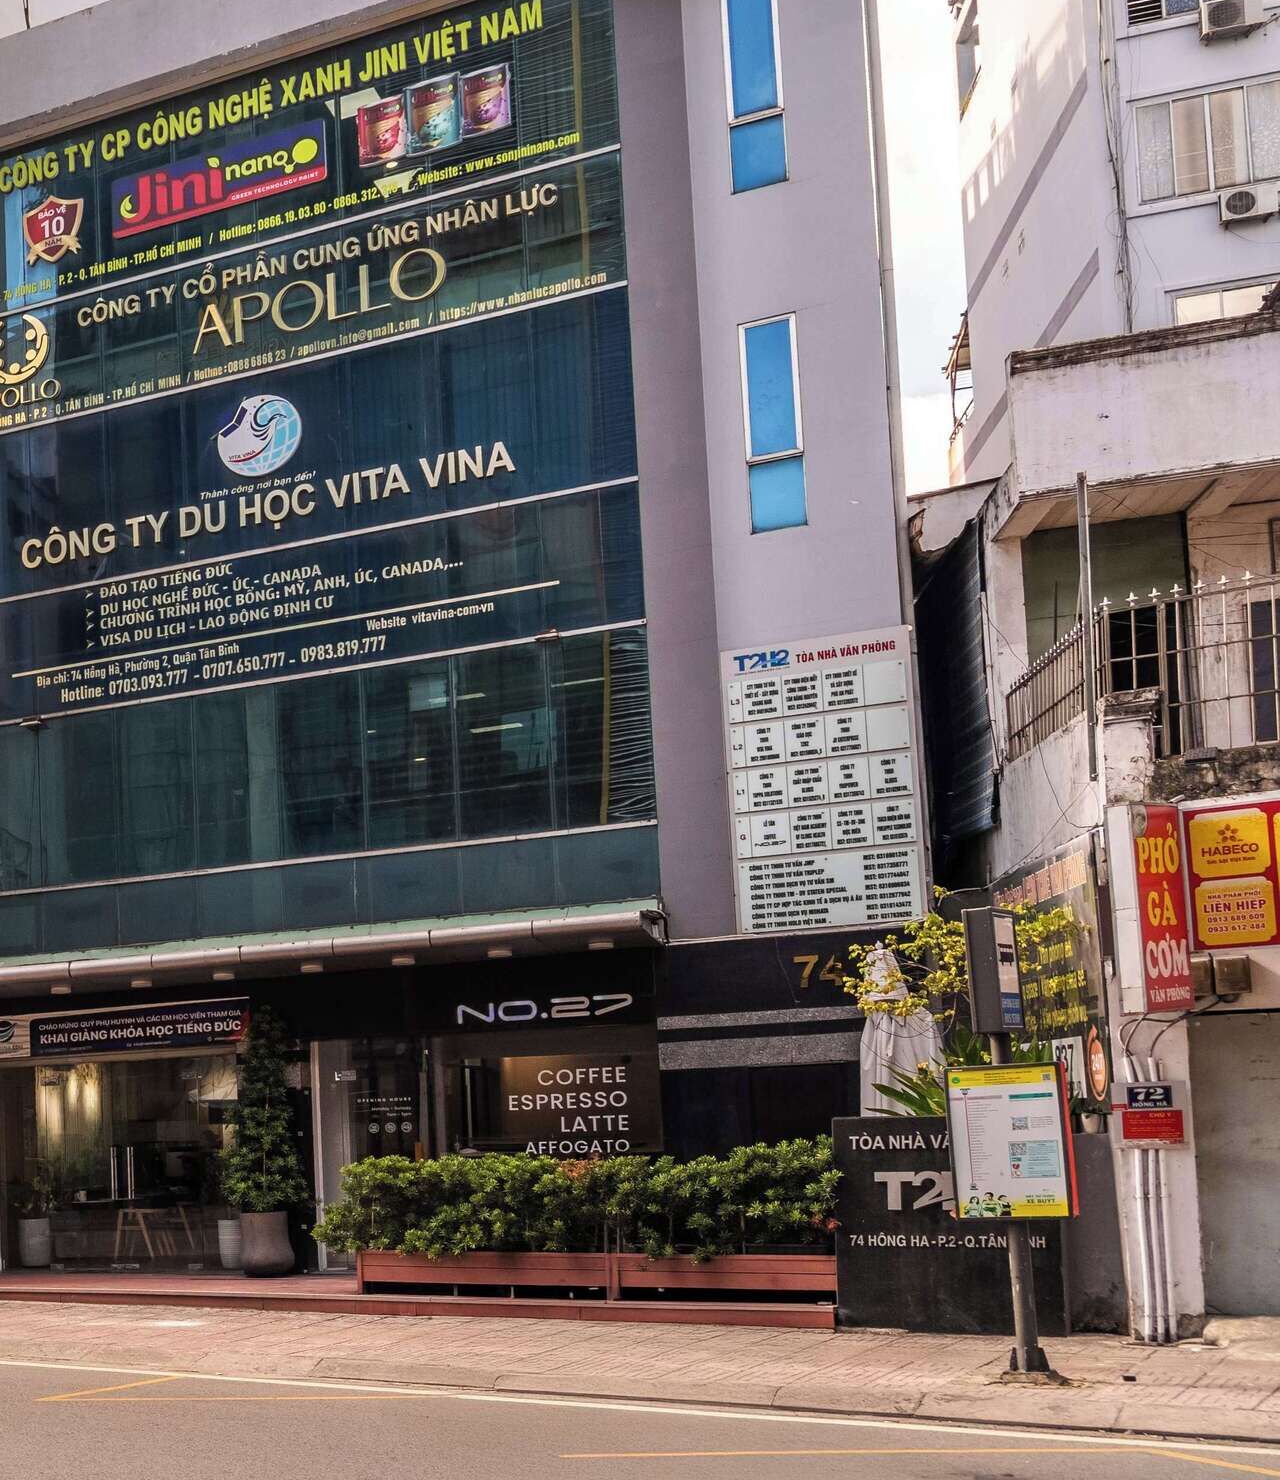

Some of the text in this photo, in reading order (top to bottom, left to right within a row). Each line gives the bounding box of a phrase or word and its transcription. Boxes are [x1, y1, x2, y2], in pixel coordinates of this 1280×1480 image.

[65, 140, 94, 172] TY
[101, 129, 130, 160] CP
[137, 106, 202, 150] CÔNG
[209, 80, 272, 130] NGHỆ
[280, 59, 351, 107] XANH
[359, 42, 406, 83] JINI
[413, 20, 471, 63] VIỆT
[120, 157, 223, 224] Jini
[177, 237, 201, 253] MINH
[465, 132, 580, 173] www.sonjininano.com
[41, 216, 64, 238] 10
[77, 183, 558, 327] CÔNG TY CỔ PHẦN CUNG ỨNG NHÂN LỰC
[193, 247, 447, 355] APOLLO
[158, 373, 181, 389] MINH
[21, 441, 516, 569] CÔNG TY DU HỌC VITA VINA
[200, 488, 229, 501] Thành
[100, 601, 120, 616] DU
[126, 594, 148, 612] HỌC
[263, 564, 322, 585] CANADA
[131, 578, 157, 595] TẠO
[161, 568, 201, 588] TIẾNG
[206, 563, 233, 579] ĐỨC
[100, 610, 154, 630] CHƯƠNG
[158, 604, 200, 624] TRÌNH
[206, 594, 232, 612] HỌC
[100, 628, 131, 647] VISA
[135, 627, 153, 641] DU
[156, 623, 185, 640] LỊCH
[199, 613, 225, 630] LAO
[229, 606, 269, 626] ĐỘNG
[273, 598, 310, 619] ĐỊNH
[71, 670, 82, 682] 74
[125, 656, 159, 675] Phường
[173, 650, 197, 665] Quận
[199, 646, 216, 661] Tân
[218, 642, 240, 657] Bình
[733, 649, 790, 672] T2H2
[795, 640, 896, 663] TÒA NHÀ VĂN PHÒNG
[61, 635, 386, 703] Hotline: 0703.093.777 0707.650.777 0983.819.777
[1136, 823, 1180, 874] PHỞ
[1201, 843, 1259, 858] HABECO
[1148, 881, 1177, 926] GÀ
[1146, 932, 1189, 979] CƠM
[207, 1010, 228, 1018] THAM
[457, 993, 632, 1025] NO.27
[40, 1016, 241, 1046] KHAI GIẢNG KHÓA HỌC TIẾNG ĐỨC
[537, 1066, 627, 1086] COFFEE
[508, 1090, 628, 1111] ESPRESSO
[1134, 1088, 1165, 1100] 72
[561, 1114, 630, 1133] LATTE
[526, 1139, 630, 1155] AFFOGATO
[849, 1131, 926, 1150] TÒA NHÀ
[849, 1235, 864, 1247] 74
